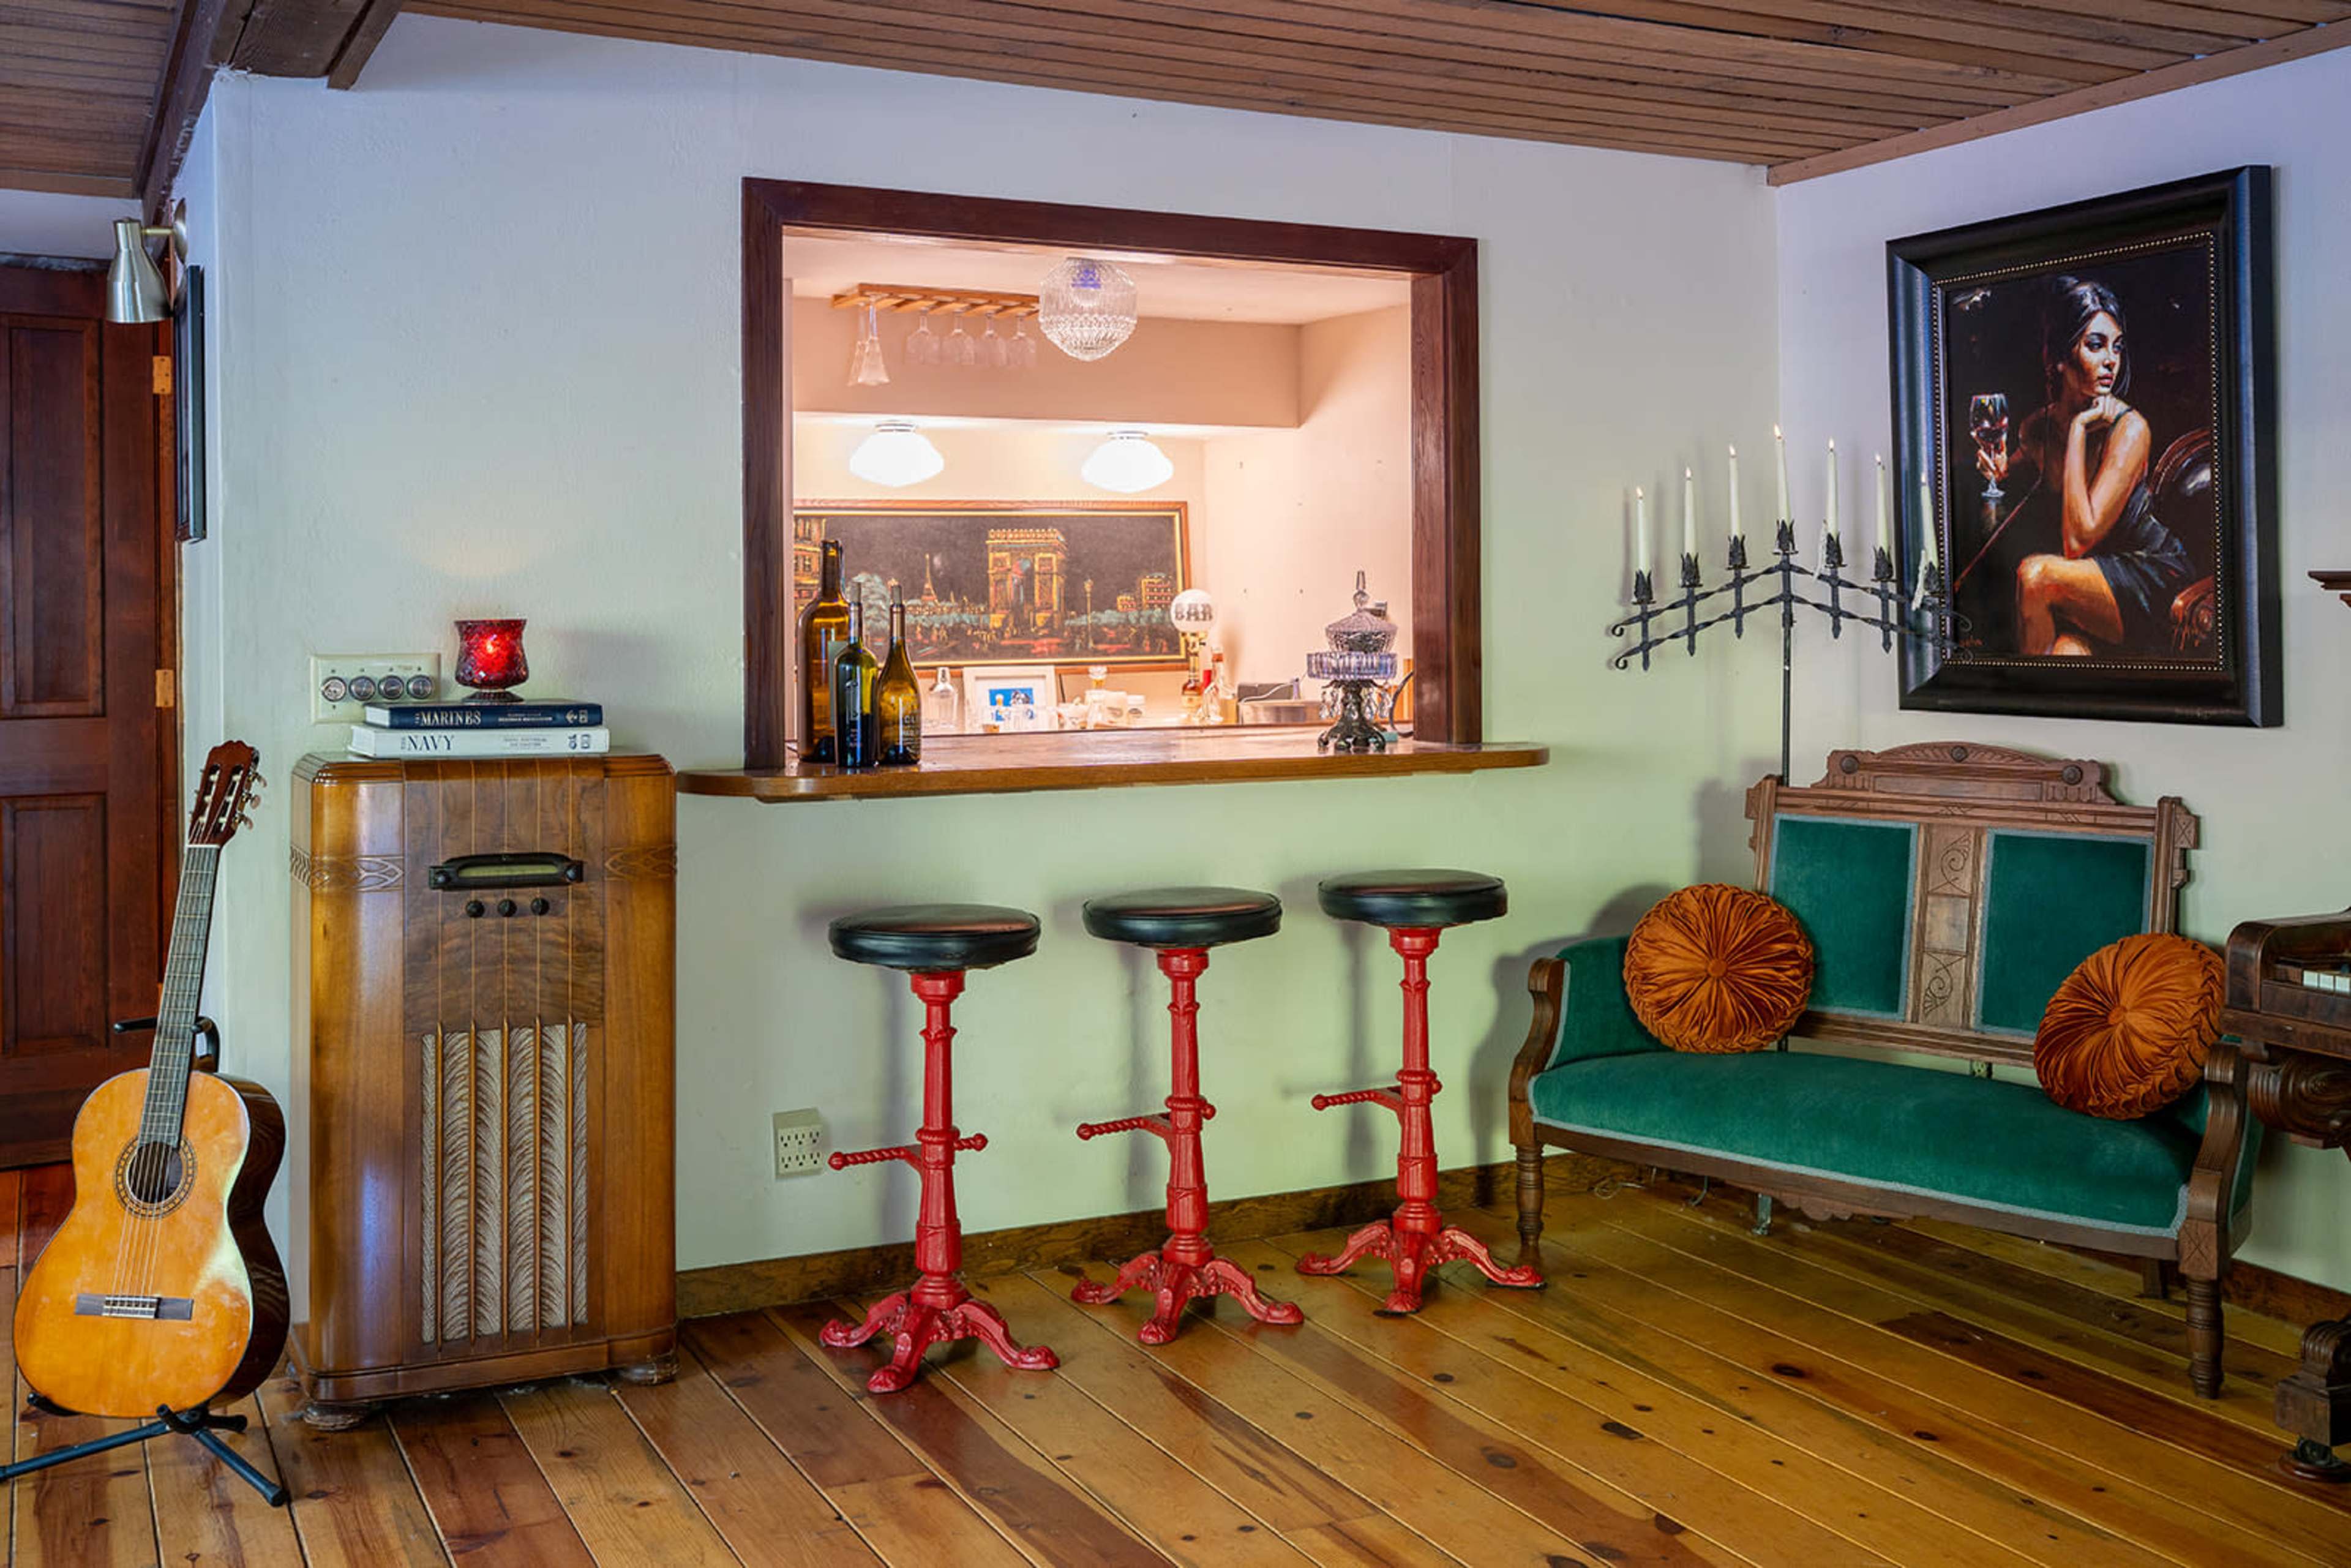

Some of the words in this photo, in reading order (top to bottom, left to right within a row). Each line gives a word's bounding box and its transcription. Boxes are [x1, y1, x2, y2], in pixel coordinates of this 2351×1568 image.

[1175, 603, 1213, 622] BAR
[420, 710, 482, 726] MARINES
[407, 735, 455, 751] NAVY
